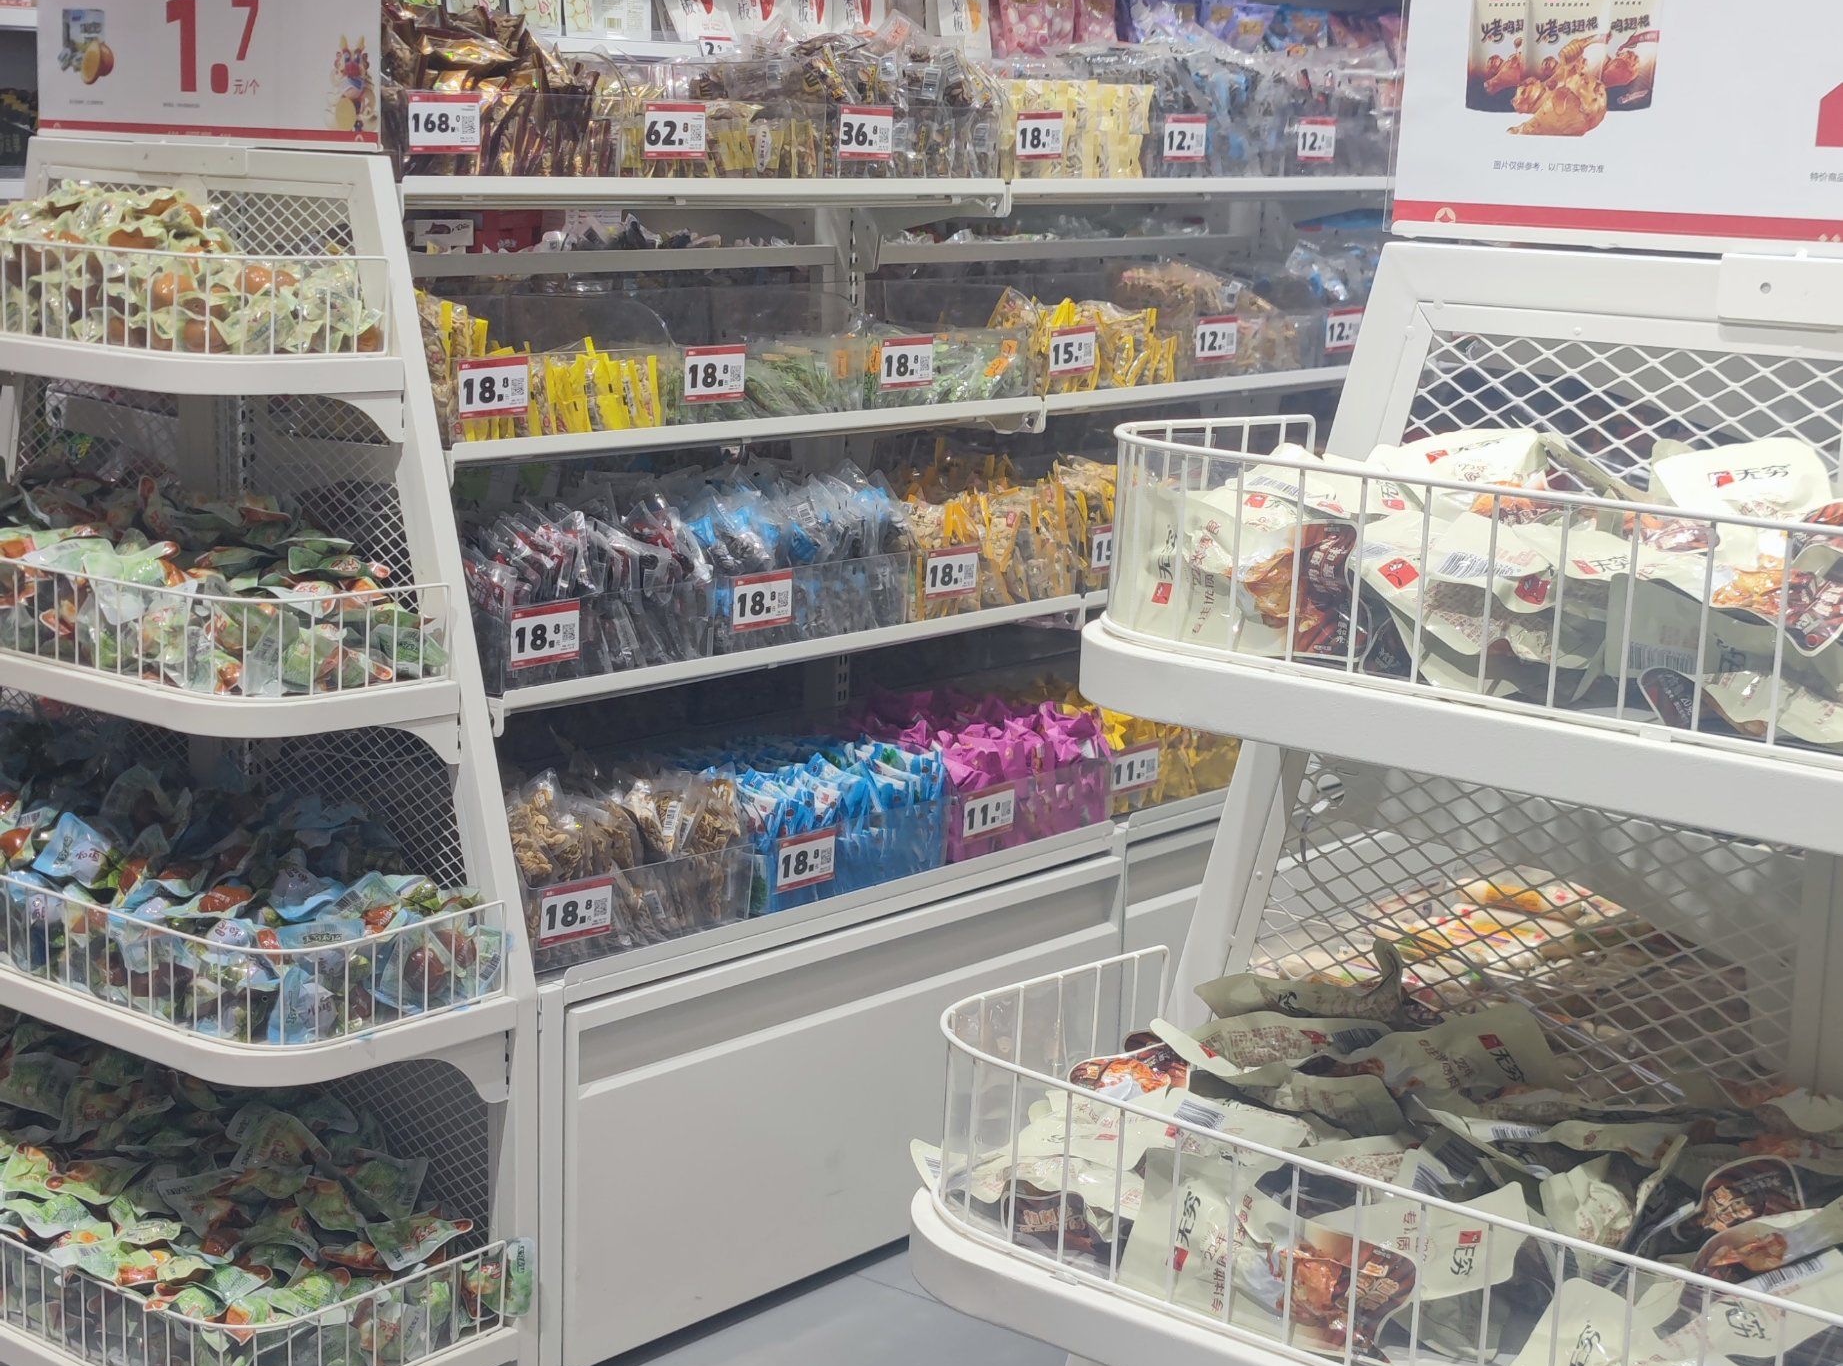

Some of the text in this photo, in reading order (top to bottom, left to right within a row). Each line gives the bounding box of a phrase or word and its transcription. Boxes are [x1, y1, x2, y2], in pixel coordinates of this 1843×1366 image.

[1536, 16, 1598, 43] 烤鸡翅根
[1611, 15, 1650, 33] 鸡翅根
[233, 79, 260, 95] 元/个
[1736, 464, 1791, 481] 无穷
[515, 622, 561, 654] 18.8
[782, 848, 820, 879] 18.8
[545, 898, 593, 931] 18.8
[1181, 1190, 1201, 1247] 无穷
